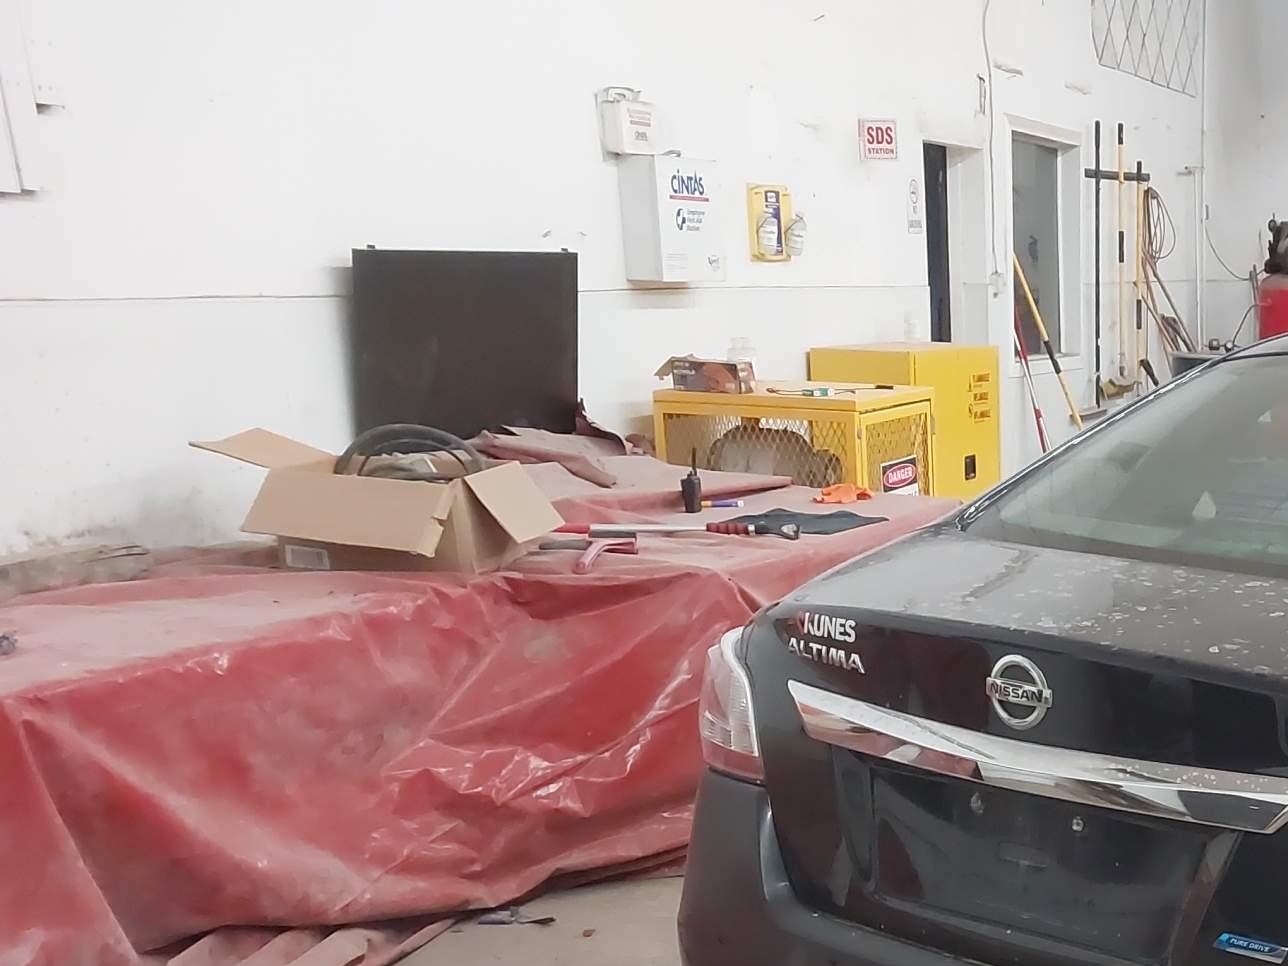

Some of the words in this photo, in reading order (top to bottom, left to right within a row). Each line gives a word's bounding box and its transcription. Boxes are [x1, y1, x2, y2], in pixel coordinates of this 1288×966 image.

[866, 126, 894, 145] SDS
[867, 147, 895, 155] STATION
[888, 466, 913, 484] DANGER
[803, 611, 857, 643] KUNES
[788, 637, 865, 674] ALTIMA
[990, 682, 1044, 703] NISSAN
[1230, 938, 1249, 947] PURE
[1249, 943, 1271, 952] DRIVE
